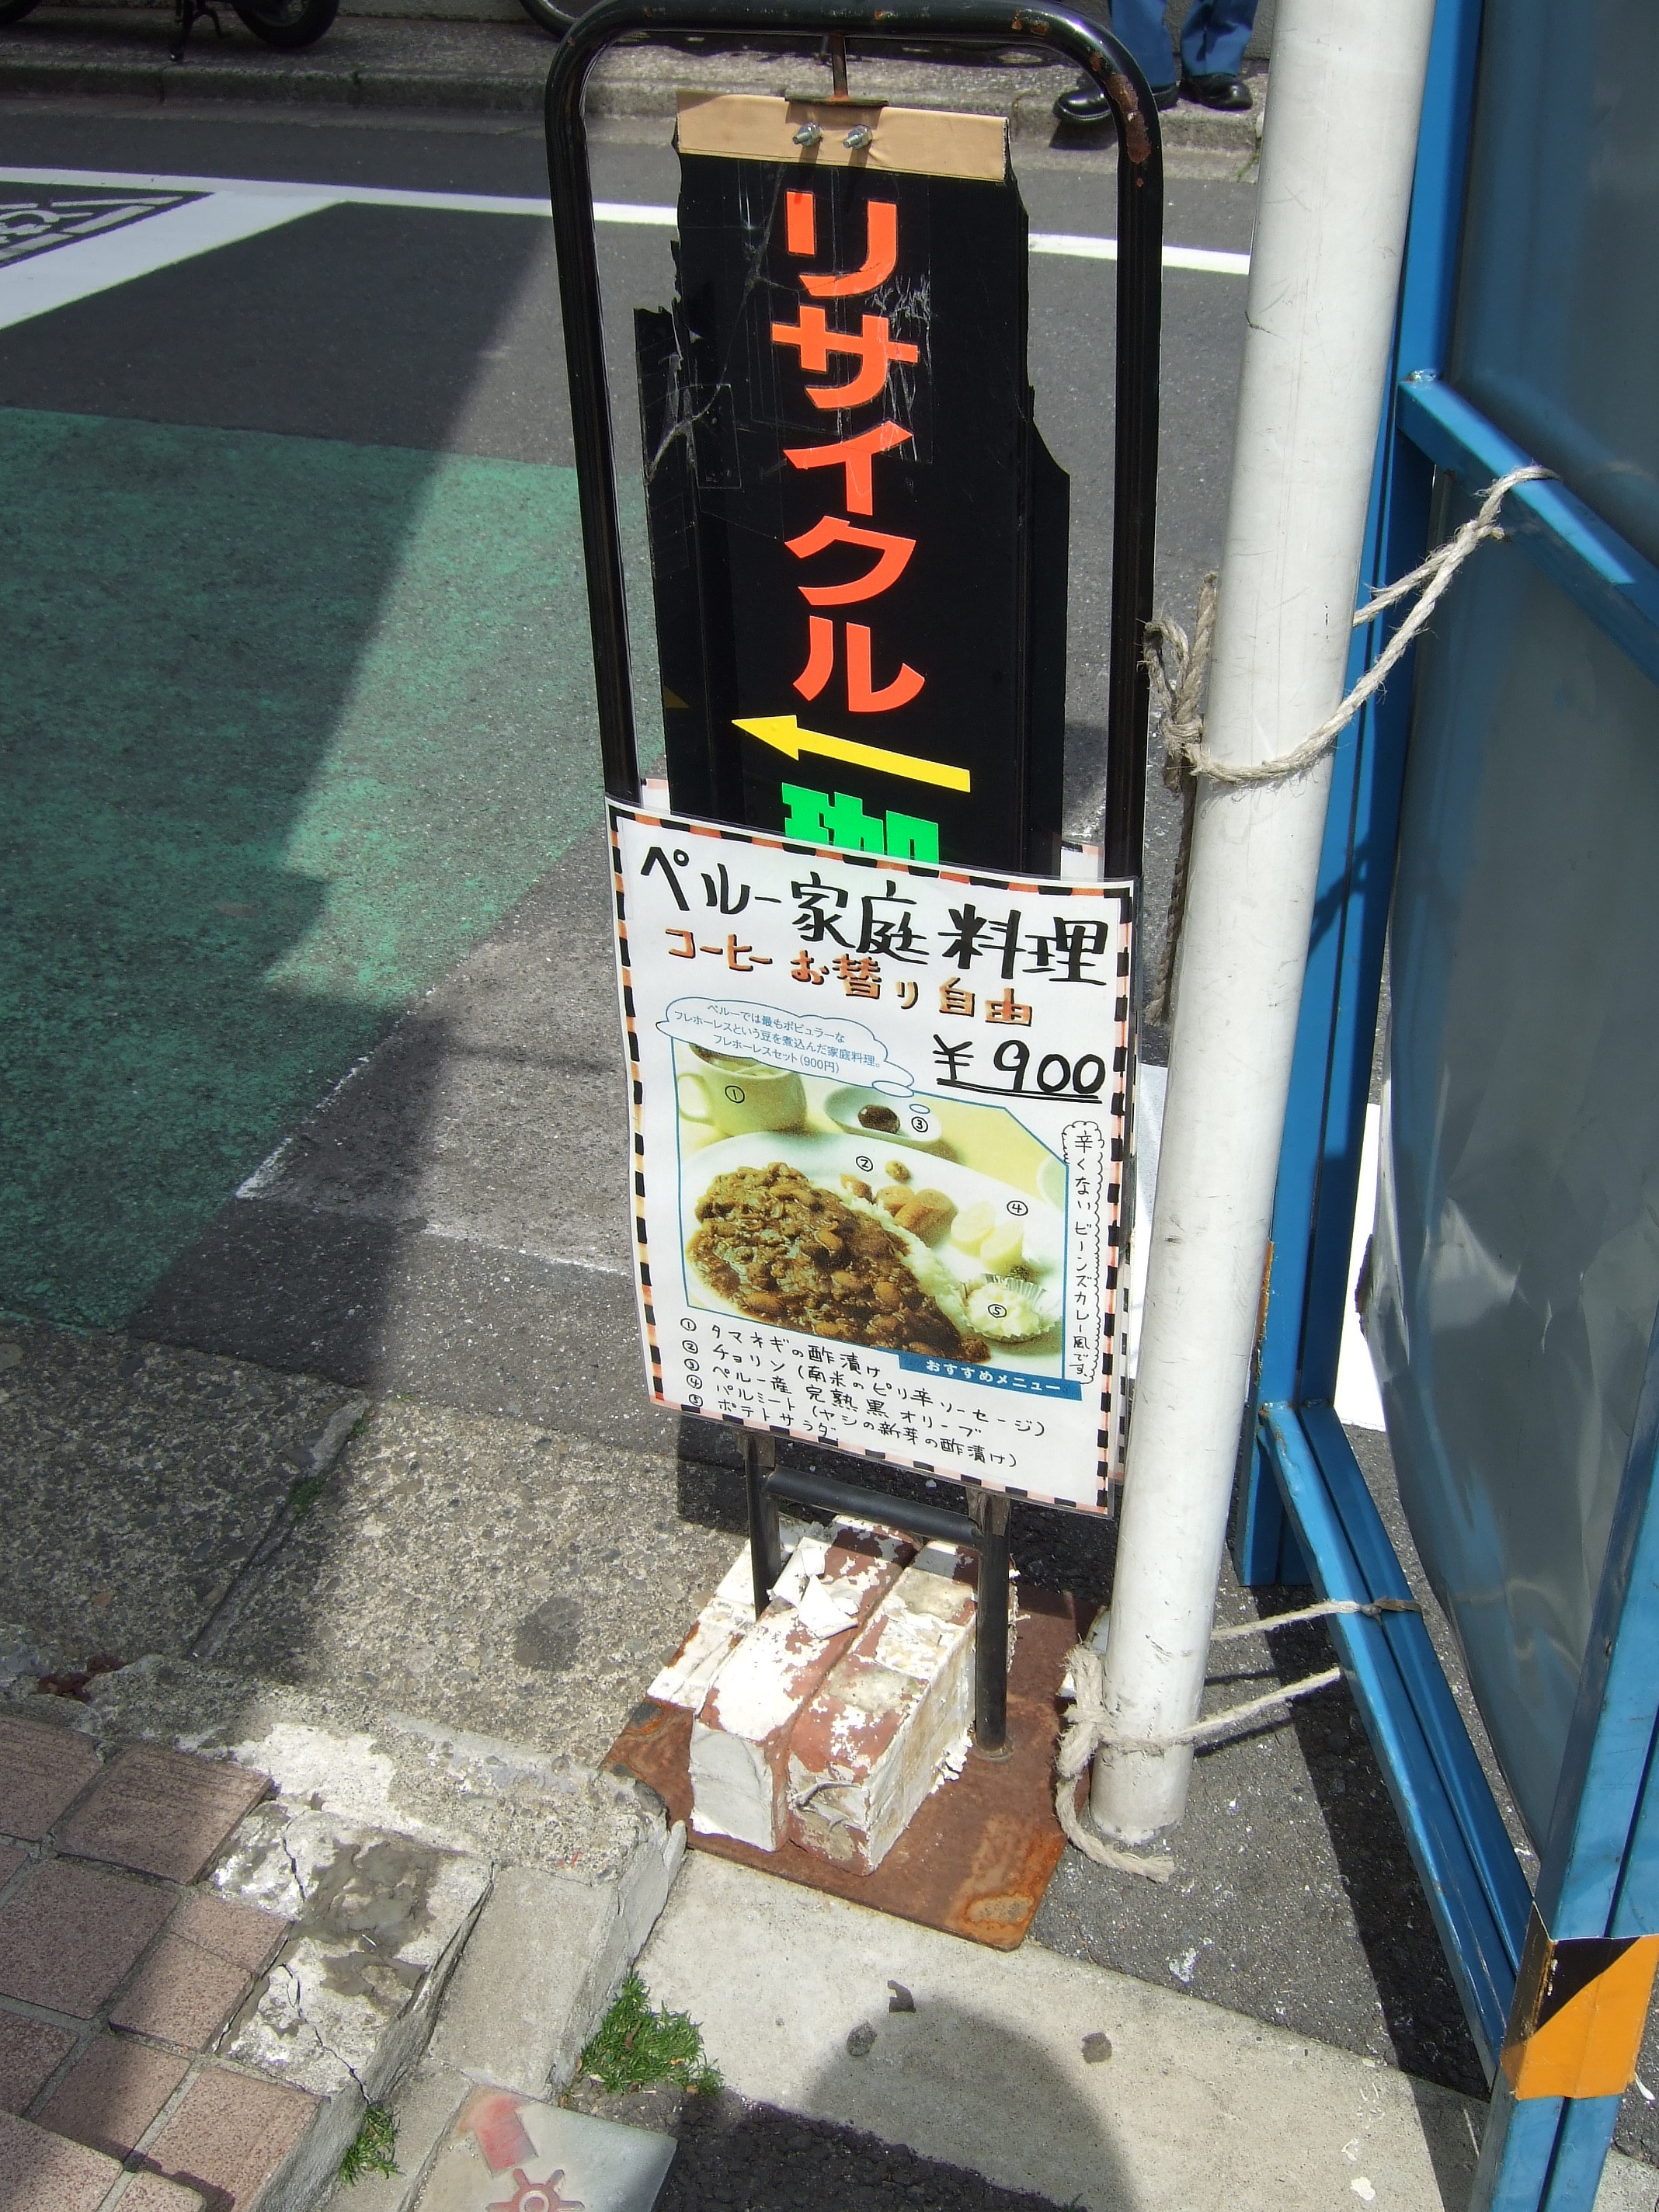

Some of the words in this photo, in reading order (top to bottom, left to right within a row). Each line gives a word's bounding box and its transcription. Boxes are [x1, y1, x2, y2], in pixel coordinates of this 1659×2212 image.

[771, 191, 925, 712] リサイクル
[641, 847, 1107, 986] ペルー家庭料理
[707, 1004, 846, 1044] ペルーでは最もポピュラーな
[925, 1359, 1061, 1392] おすすめメニュー
